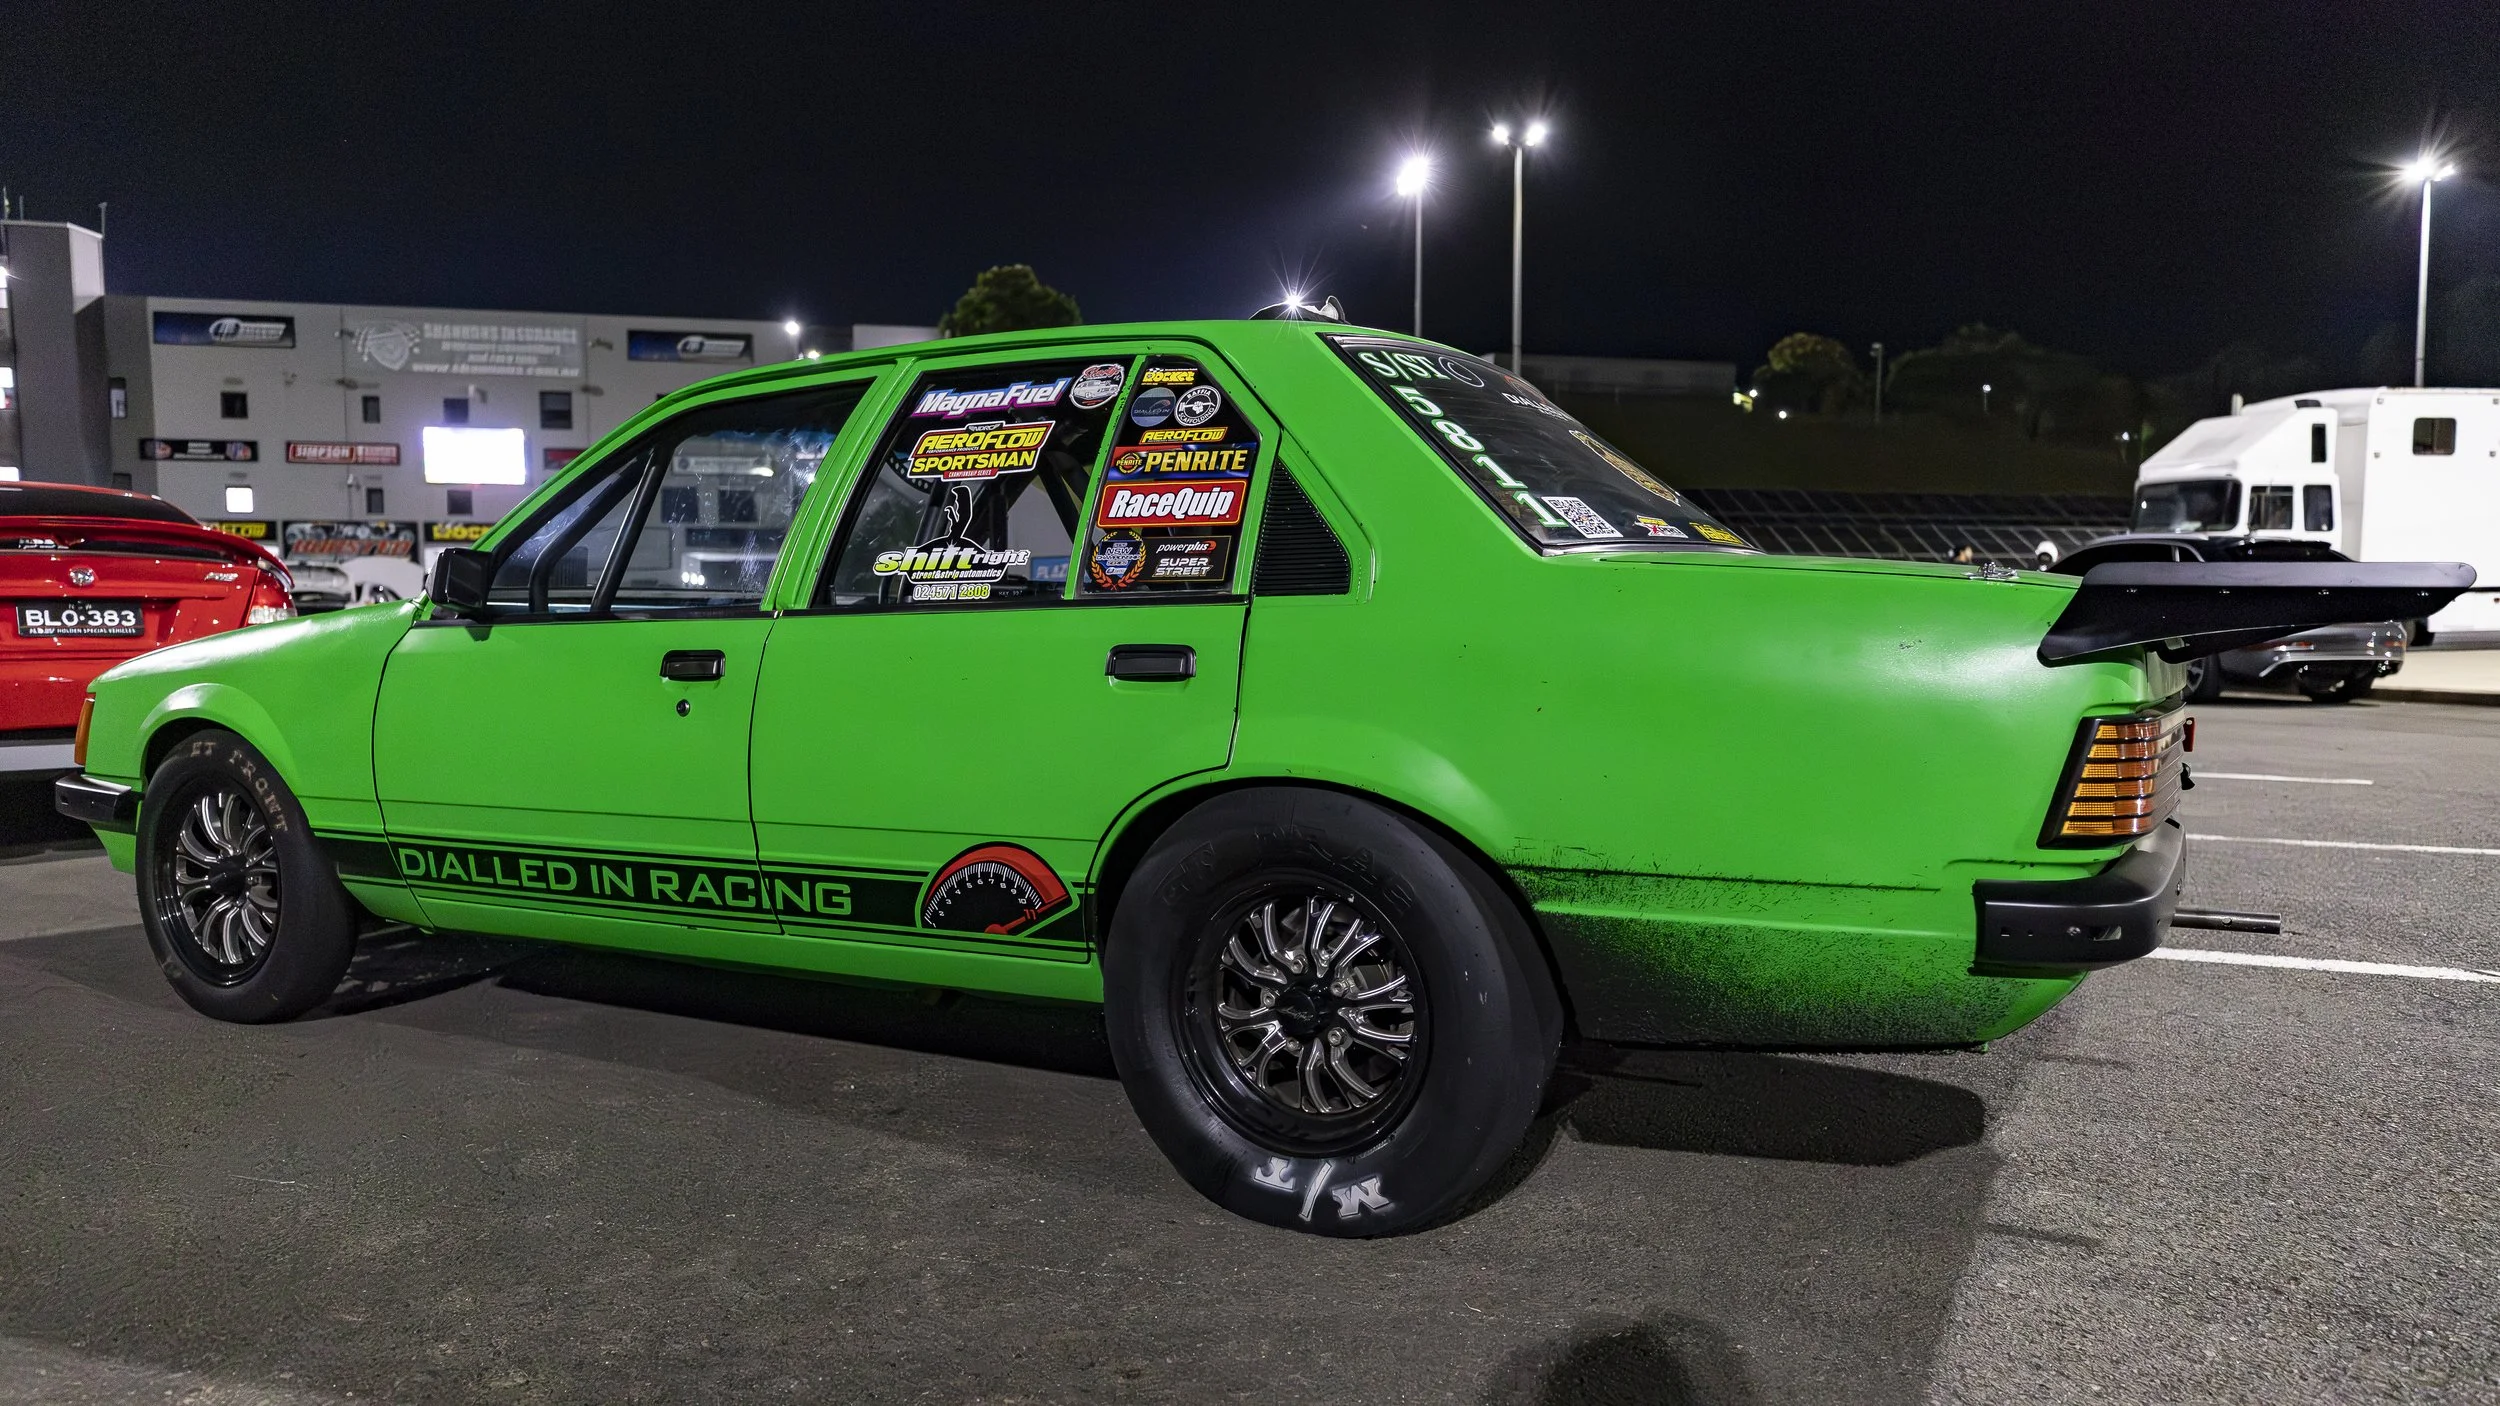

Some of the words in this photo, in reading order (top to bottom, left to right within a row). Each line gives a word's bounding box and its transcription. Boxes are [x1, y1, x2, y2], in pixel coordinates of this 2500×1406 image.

[918, 380, 1066, 415] MagnaFuel
[1187, 388, 1211, 399] RAFFIA
[1178, 407, 1215, 424] SCAFFOLDING
[917, 427, 1047, 455] AEROFLOW
[1142, 429, 1225, 443] AEROFLOW
[912, 450, 1036, 473] SPORTSMAN
[1116, 459, 1143, 467] PENRITE
[1143, 449, 1249, 473] PENRITE
[1107, 486, 1235, 519] RaceQuip
[1155, 541, 1209, 553] powerplus
[1158, 557, 1209, 567] SUPER
[959, 569, 1002, 578] automatics
[1155, 566, 1211, 576] STREET
[959, 585, 989, 598] 2808
[229, 750, 288, 832] FRONT
[399, 848, 578, 892] DIALLED
[591, 865, 637, 897] IN
[654, 870, 852, 917] RACING
